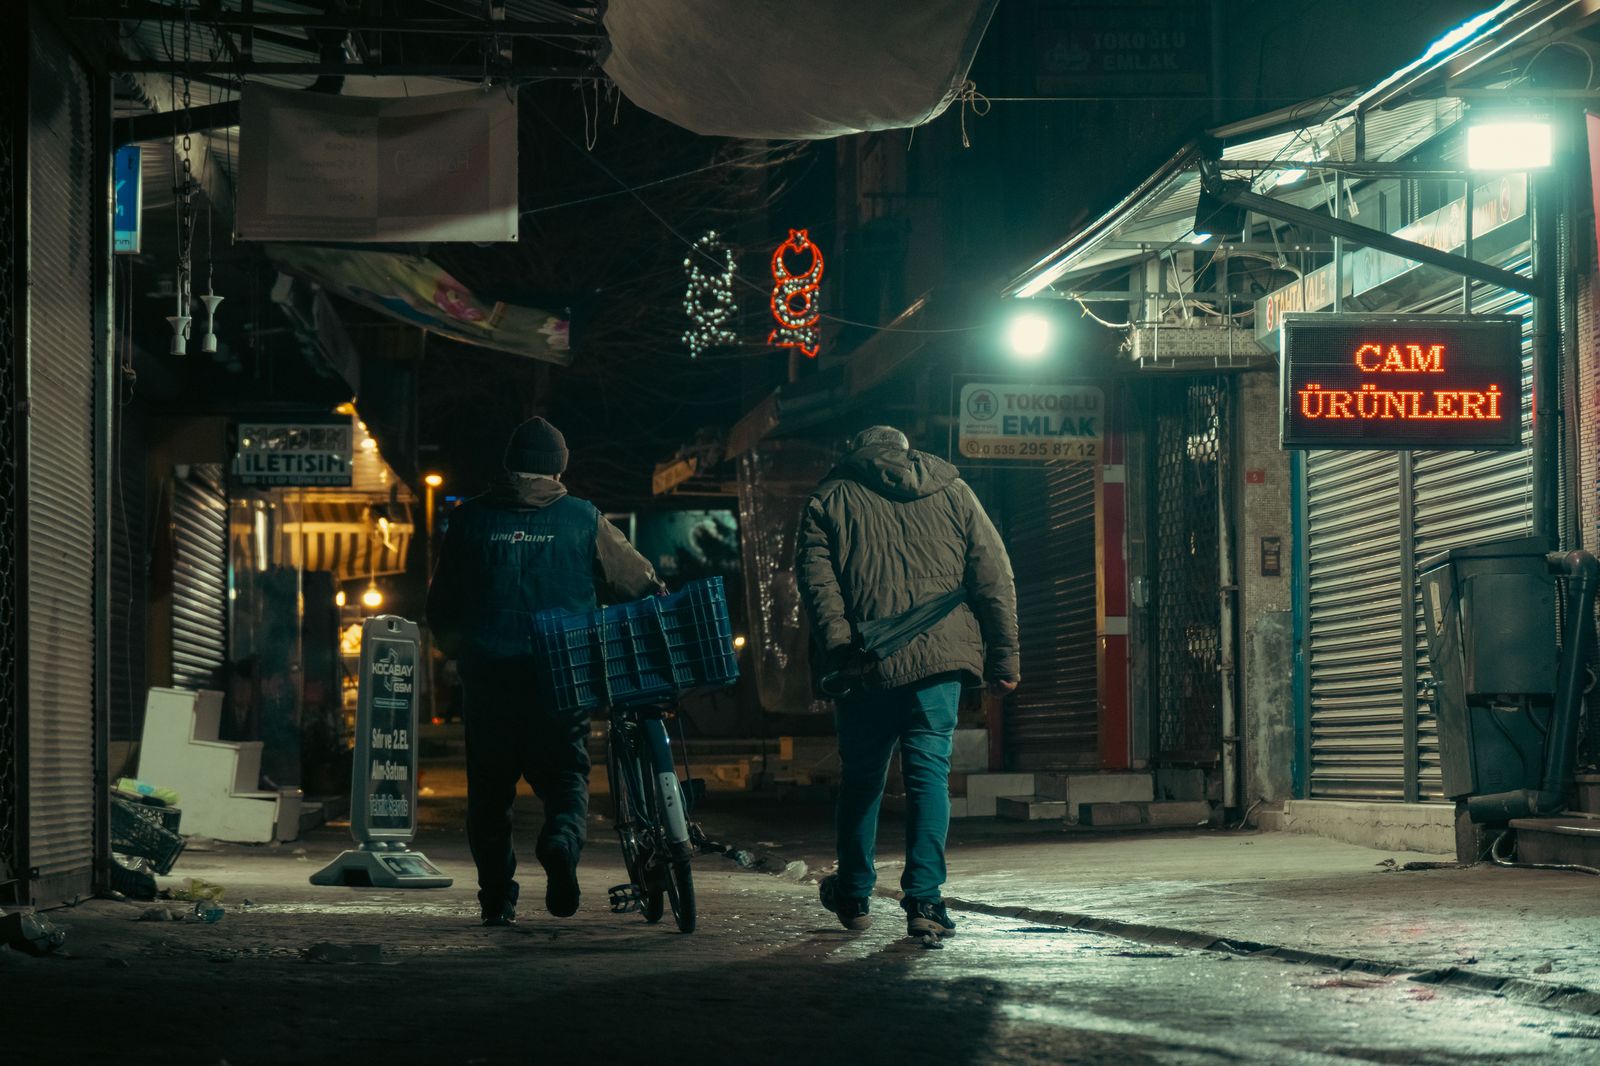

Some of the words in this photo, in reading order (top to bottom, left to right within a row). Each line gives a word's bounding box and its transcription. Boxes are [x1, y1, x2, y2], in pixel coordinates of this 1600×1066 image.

[1103, 53, 1180, 71] EMLAK
[1355, 344, 1445, 372] CAM
[1298, 384, 1502, 419] ÜRÜNLERİ
[1002, 415, 1096, 437] EMLAK
[1019, 442, 1048, 456] 295
[1053, 442, 1073, 456] 87
[1078, 443, 1096, 457] 12
[372, 662, 413, 677] KOCABAY
[393, 682, 412, 693] GSM
